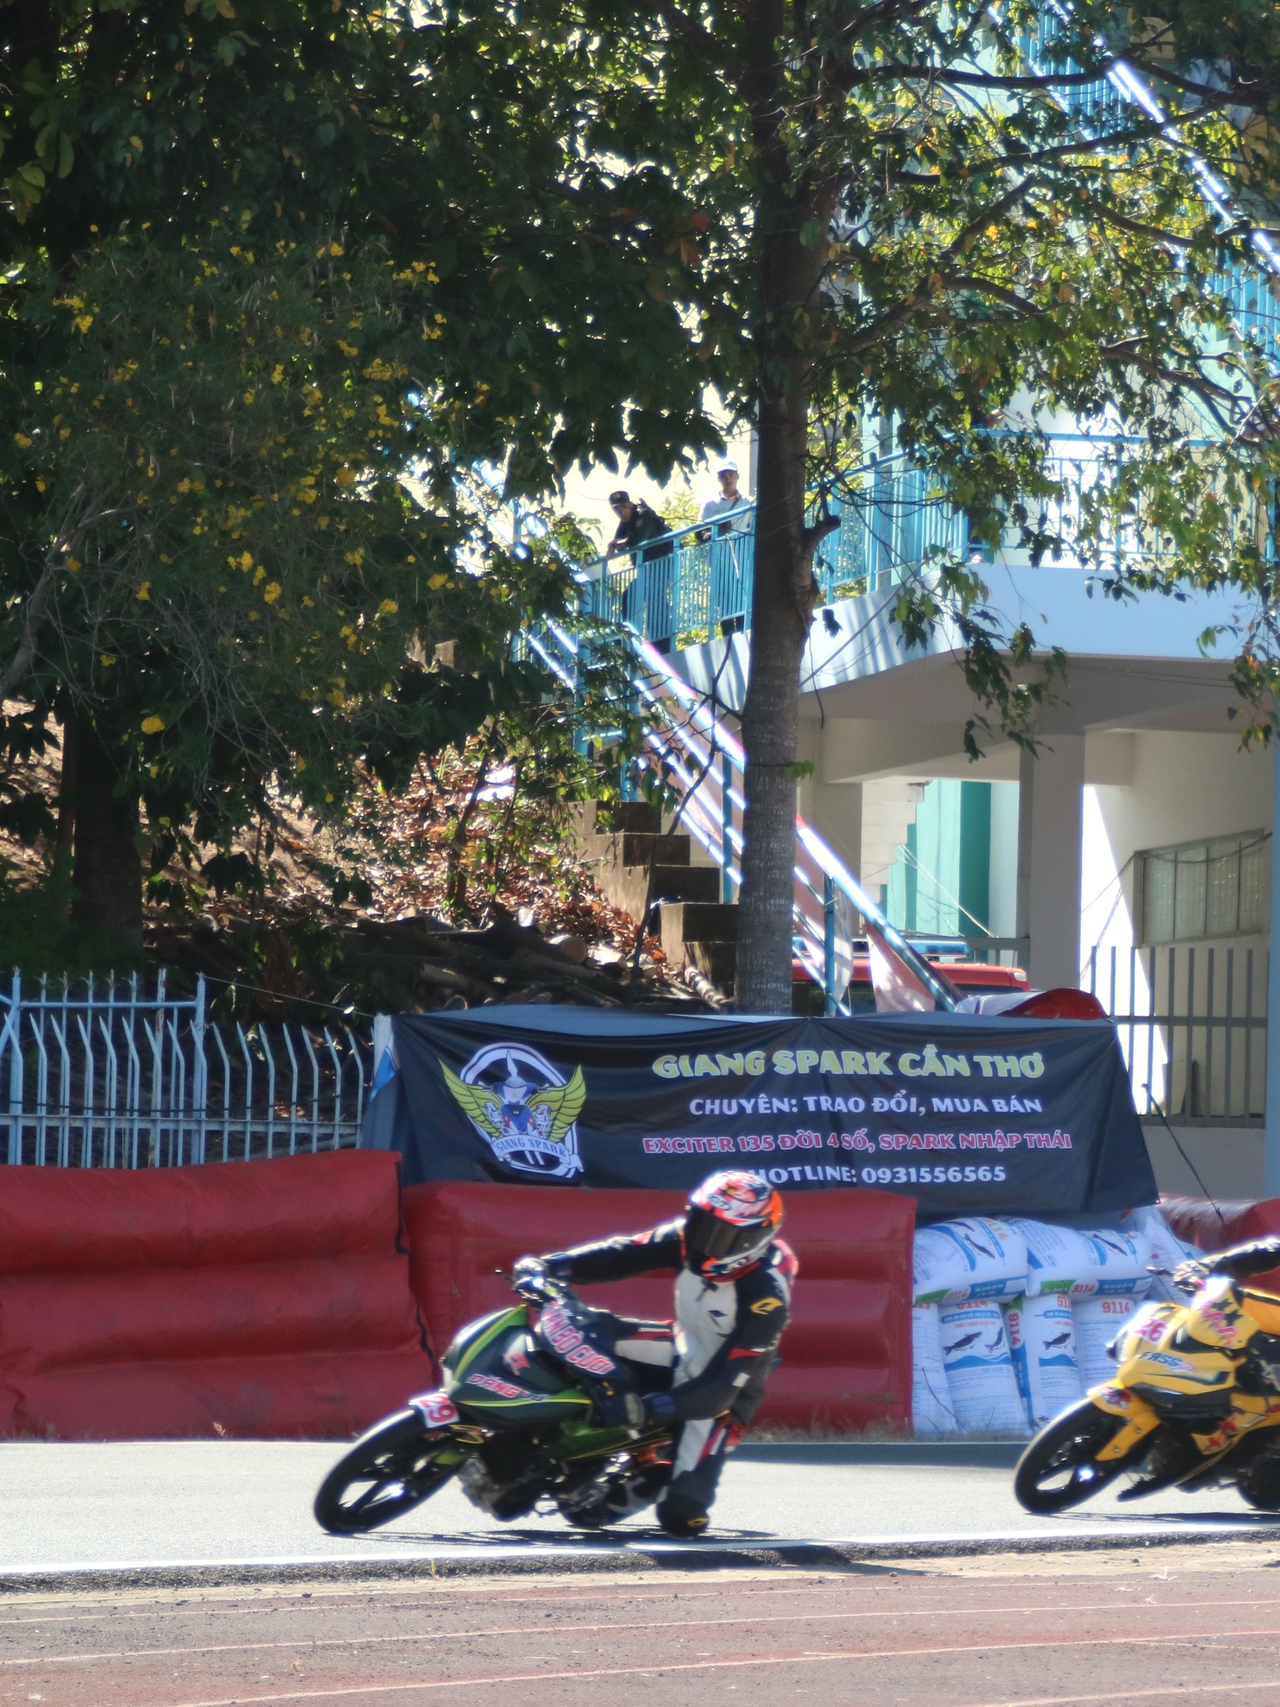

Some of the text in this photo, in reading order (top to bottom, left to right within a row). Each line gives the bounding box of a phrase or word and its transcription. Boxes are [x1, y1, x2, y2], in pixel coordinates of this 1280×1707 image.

[652, 1044, 1045, 1079] GIANG SPARK CẦN THƠ
[689, 1089, 1043, 1116] CHUYÊN: TRAO ĐỔI, MUA BÁN
[495, 1137, 567, 1159] GIANG SPARK
[642, 1128, 1073, 1154] EXCITER 135 ĐỜI 4 SỐ, SPARK NHẬP THÁI
[861, 1166, 1007, 1184] 0931556565
[1070, 1283, 1097, 1294] 9114
[1101, 1301, 1131, 1315] 9114
[1008, 1312, 1021, 1346] 9114
